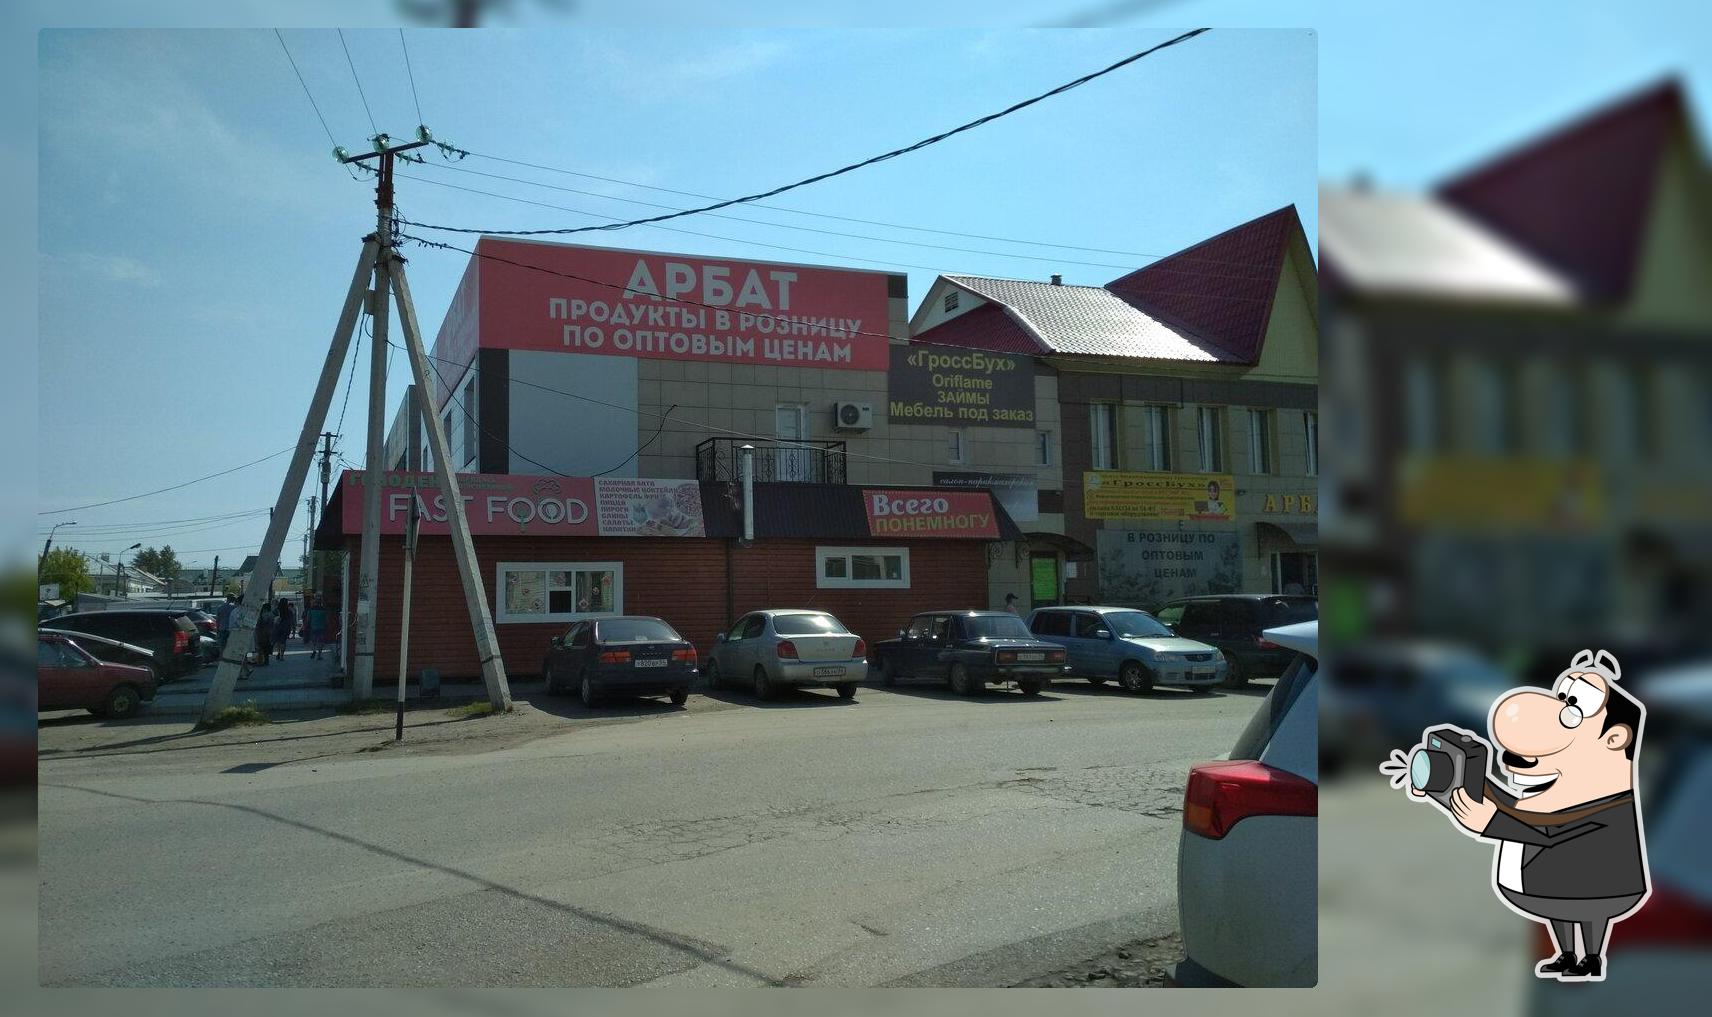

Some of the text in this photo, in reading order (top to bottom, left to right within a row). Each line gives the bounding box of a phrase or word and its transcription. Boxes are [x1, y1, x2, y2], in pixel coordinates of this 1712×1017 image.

[623, 259, 798, 311] АРБАТ
[549, 298, 863, 341] ПРОДУКТЫ В РОЗНИЦУ
[563, 324, 852, 362] ПО ОПТОВЫМ ЦЕНАМ
[906, 350, 1016, 374] «ГроссБух»
[932, 373, 994, 390] Oriflame
[937, 389, 991, 405] ЗАЙМЫ
[890, 401, 1034, 422] Мебель под заказ
[487, 496, 589, 525] FOOD
[872, 494, 949, 516] Всего
[1264, 494, 1318, 513] АРБ
[875, 513, 990, 533] ПОНЕМНОГУ
[1127, 532, 1216, 544] В РОЗНИЦУ ПО
[1142, 550, 1204, 561] ОПТОВЫМ
[1154, 568, 1198, 578] ЦЕНАМ
